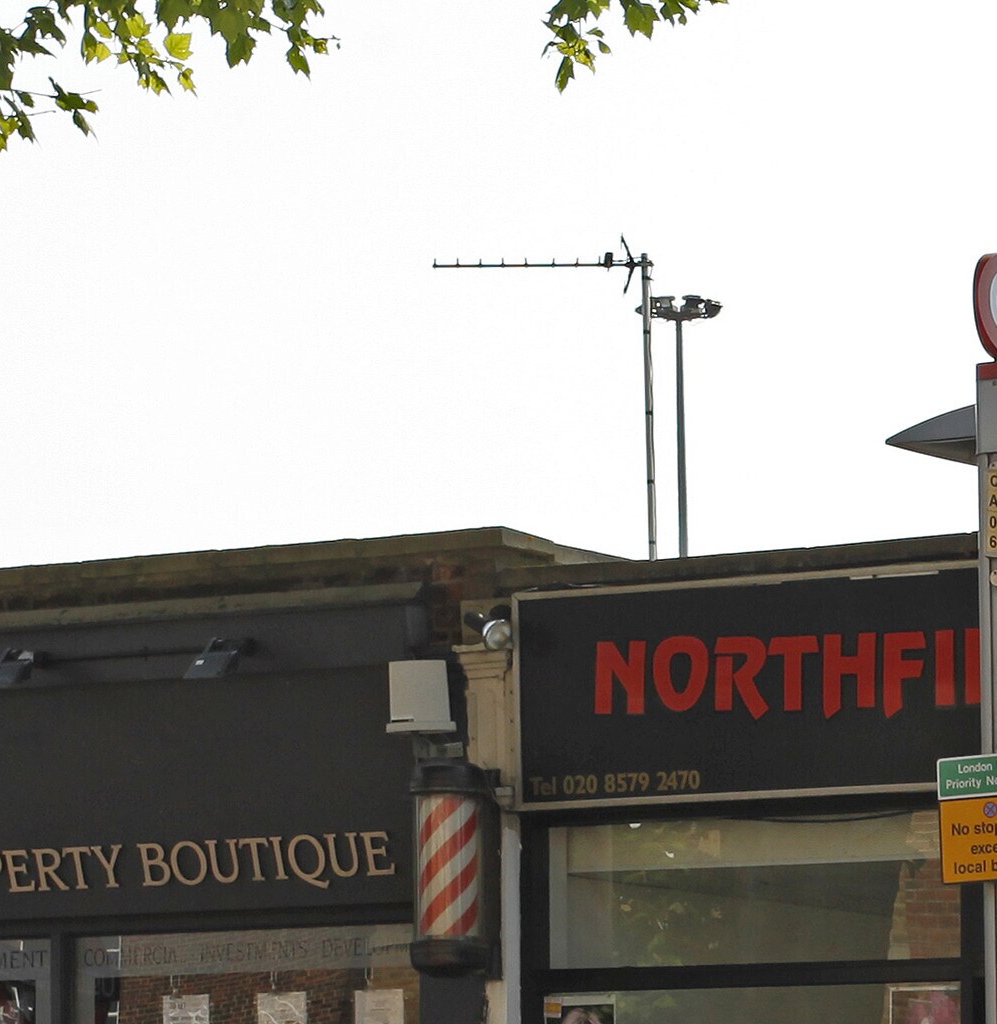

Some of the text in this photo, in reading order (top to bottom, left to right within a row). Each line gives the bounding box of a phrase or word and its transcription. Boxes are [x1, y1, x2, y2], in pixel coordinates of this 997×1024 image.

[958, 763, 993, 774] London
[529, 770, 701, 796] Tel 020 8579 2470
[946, 777, 982, 789] Priority
[952, 823, 970, 836] No
[136, 831, 396, 890] BOUTIQUE
[954, 860, 986, 875] local
